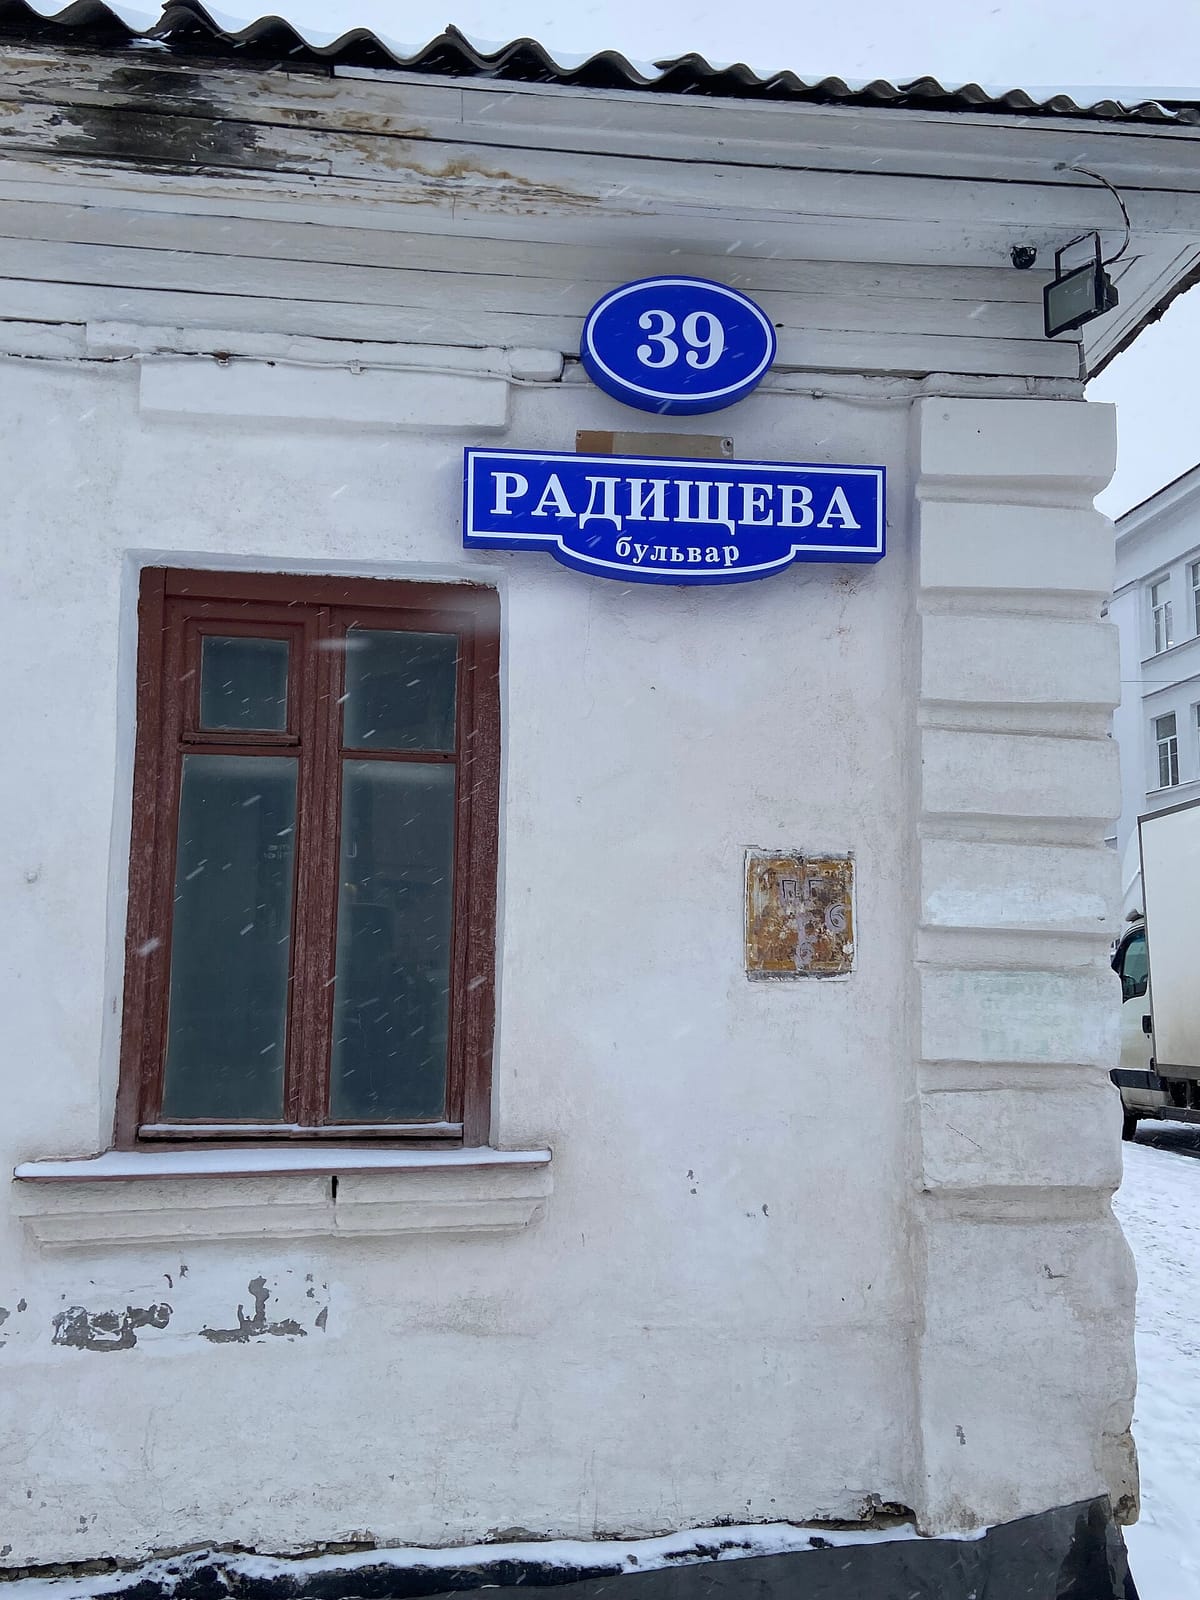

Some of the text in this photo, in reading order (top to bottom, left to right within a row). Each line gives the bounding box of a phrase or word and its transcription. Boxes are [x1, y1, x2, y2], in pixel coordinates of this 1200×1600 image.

[636, 309, 725, 370] 39
[489, 471, 861, 535] РАДИЩЕВА
[615, 536, 740, 567] бульвар
